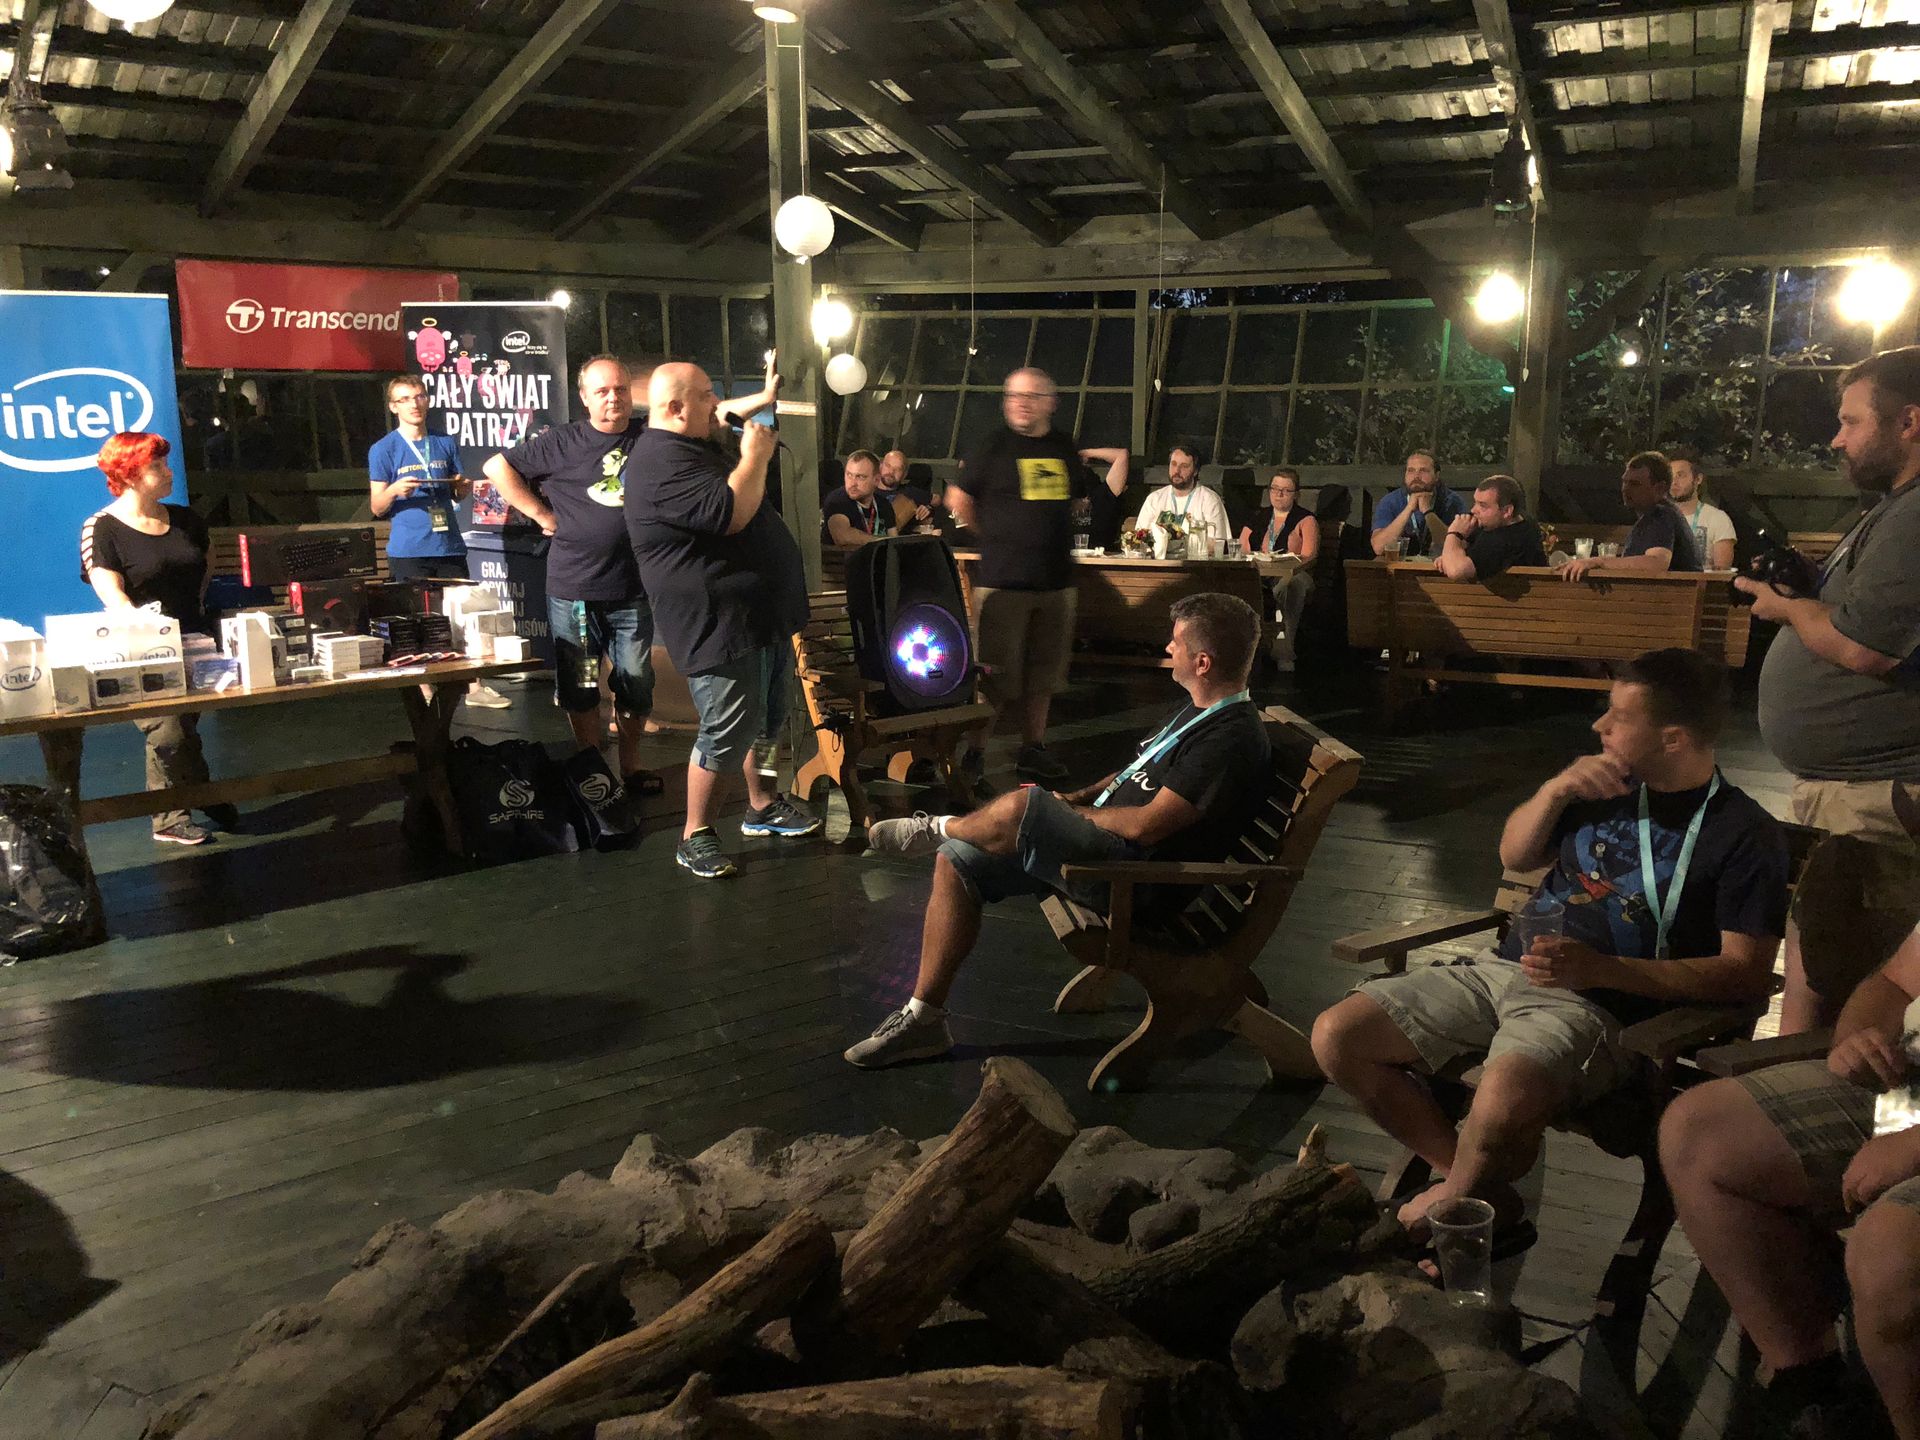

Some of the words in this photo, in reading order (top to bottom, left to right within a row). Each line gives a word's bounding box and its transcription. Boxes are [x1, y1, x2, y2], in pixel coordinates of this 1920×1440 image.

[270, 307, 400, 331] Transcend
[481, 368, 551, 410] ŚWIAT
[1, 391, 126, 440] intel
[446, 412, 529, 448] PATRZY
[481, 561, 508, 578] GRAJ
